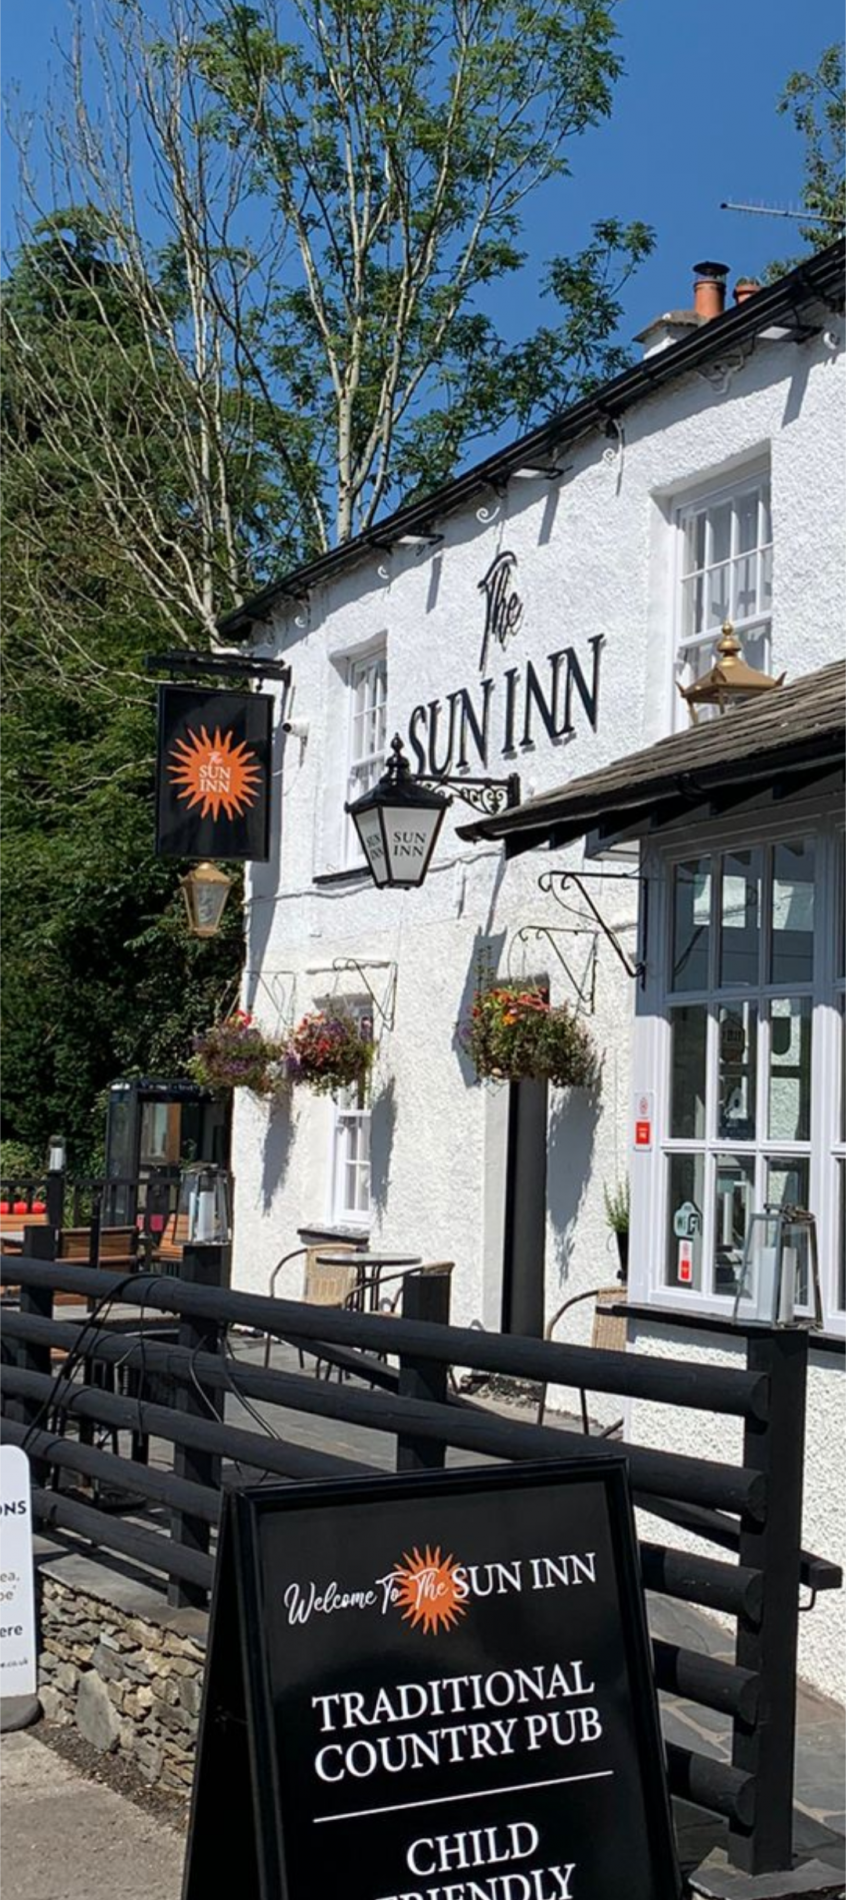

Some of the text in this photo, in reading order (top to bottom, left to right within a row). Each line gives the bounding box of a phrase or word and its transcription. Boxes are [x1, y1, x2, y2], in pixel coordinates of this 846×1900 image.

[477, 551, 523, 671] The
[409, 633, 604, 776] SUN INN
[199, 765, 230, 779] SUN
[200, 779, 229, 793] INN
[394, 831, 427, 844] SUN
[394, 845, 424, 857] INN
[0, 1500, 27, 1517] NS
[284, 1552, 596, 1625] Welcome To The SUN INN
[312, 1660, 595, 1732] TRADITIONAL
[314, 1706, 602, 1782] COUNTRY PUB
[406, 1822, 539, 1876] CHILD
[375, 1863, 576, 1900] NDLY
